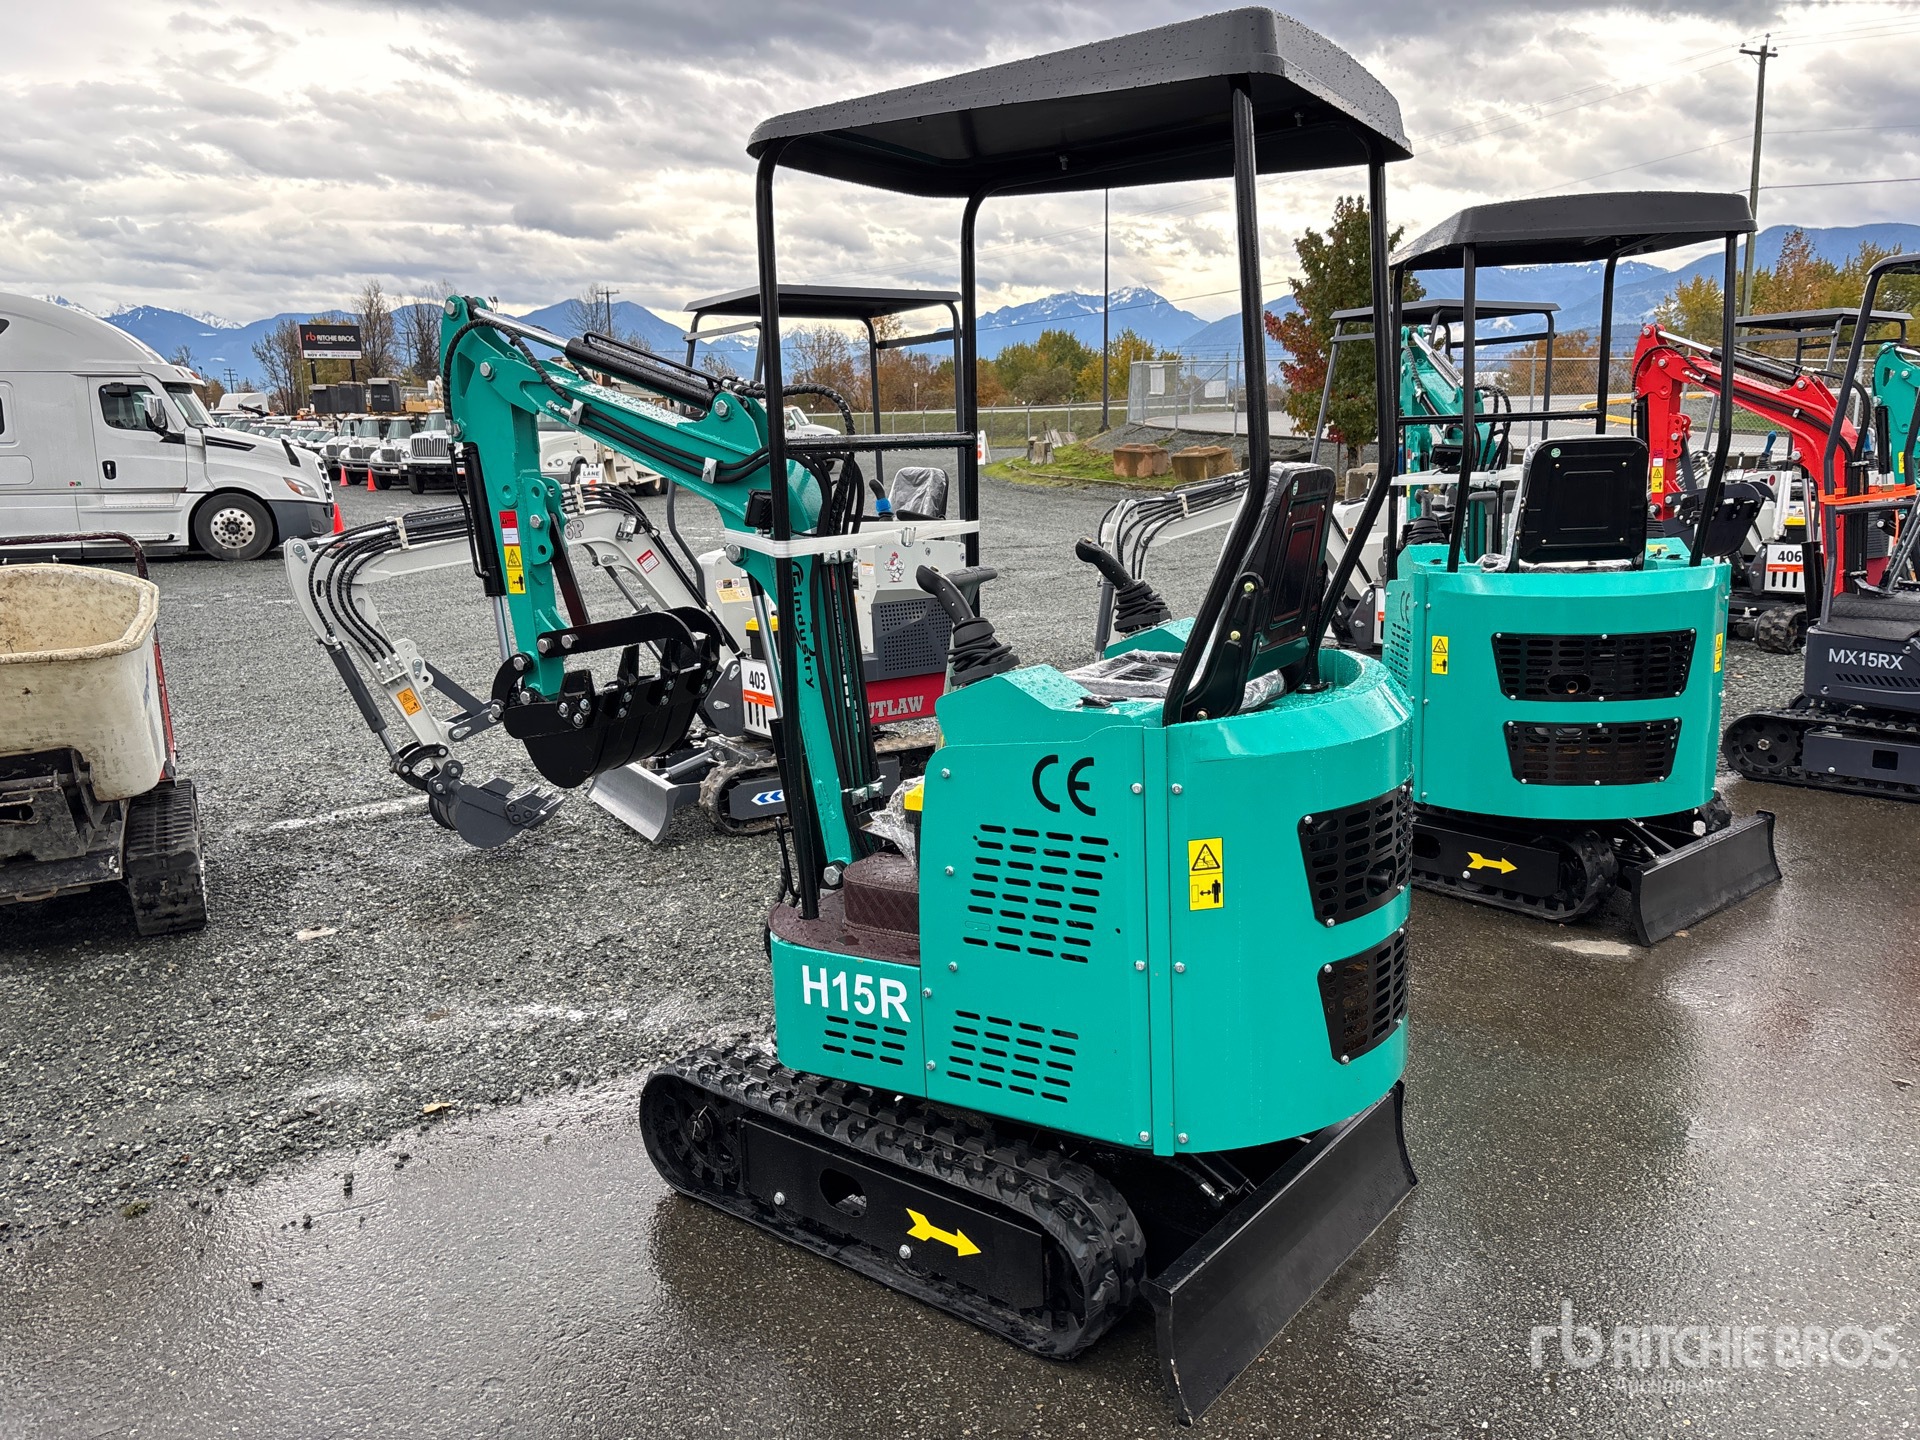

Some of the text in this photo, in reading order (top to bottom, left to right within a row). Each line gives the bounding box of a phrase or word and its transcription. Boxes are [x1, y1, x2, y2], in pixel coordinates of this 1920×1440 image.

[305, 332, 316, 341] rb
[1777, 550, 1802, 562] 406
[1828, 648, 1904, 671] MX15RX
[749, 670, 766, 691] 403
[868, 695, 924, 719] UTLAW
[1032, 754, 1096, 816] CE
[801, 964, 911, 1023] H15R
